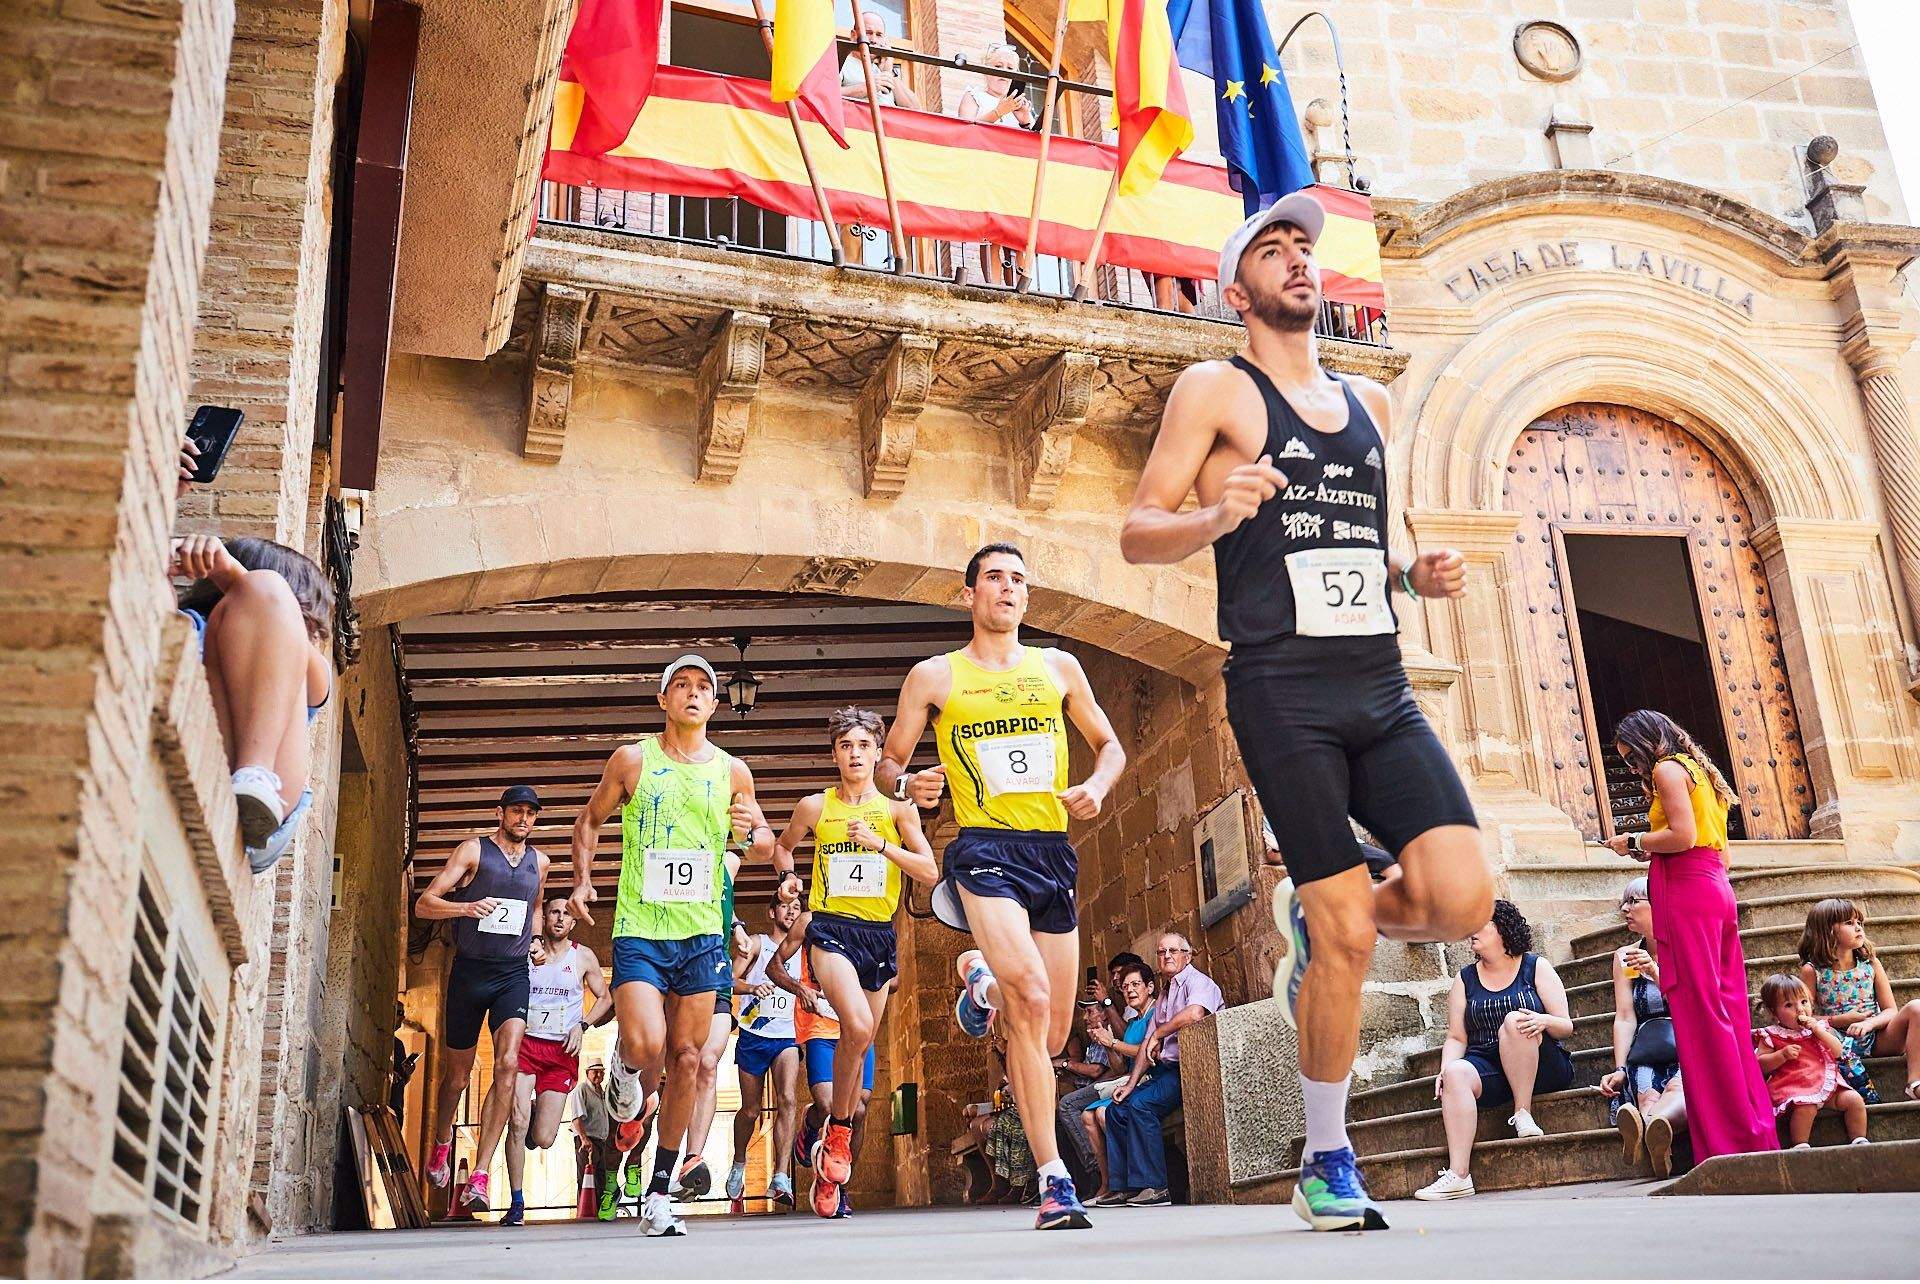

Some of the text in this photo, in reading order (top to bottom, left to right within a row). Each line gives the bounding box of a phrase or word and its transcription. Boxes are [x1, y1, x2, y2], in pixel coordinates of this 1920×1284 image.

[1445, 241, 1755, 318] CASA DE LA VILLA
[1322, 570, 1367, 607] 52
[1008, 749, 1028, 774] 8
[664, 862, 693, 886] 19
[849, 864, 864, 883] 4
[663, 888, 696, 897] ALVARO
[843, 885, 871, 893] CARLOS
[498, 907, 509, 923] 2
[770, 996, 787, 1010] 10
[541, 1011, 550, 1024] 7
